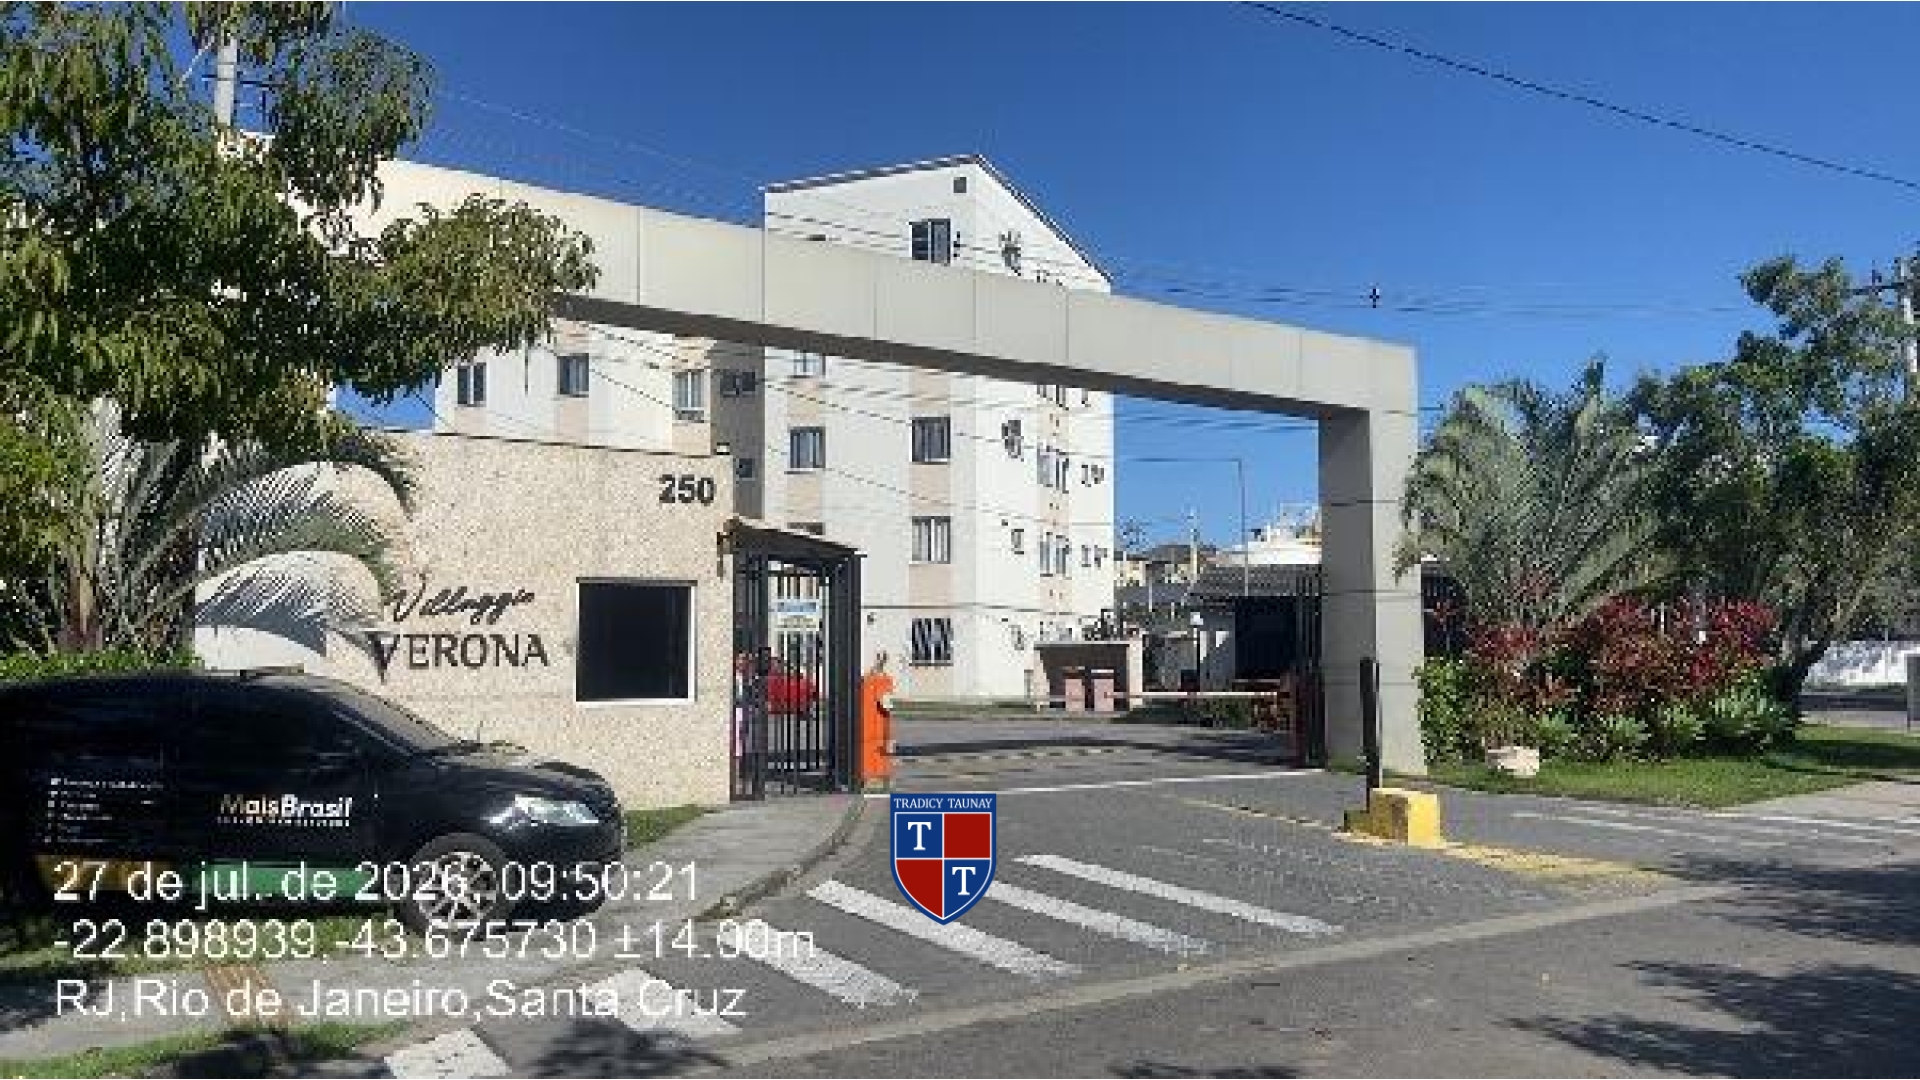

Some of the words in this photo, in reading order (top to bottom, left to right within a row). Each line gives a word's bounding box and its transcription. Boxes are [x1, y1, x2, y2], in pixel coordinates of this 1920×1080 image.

[659, 474, 716, 504] 250
[369, 630, 548, 674] VERONA
[220, 794, 352, 817] MaisBrasil
